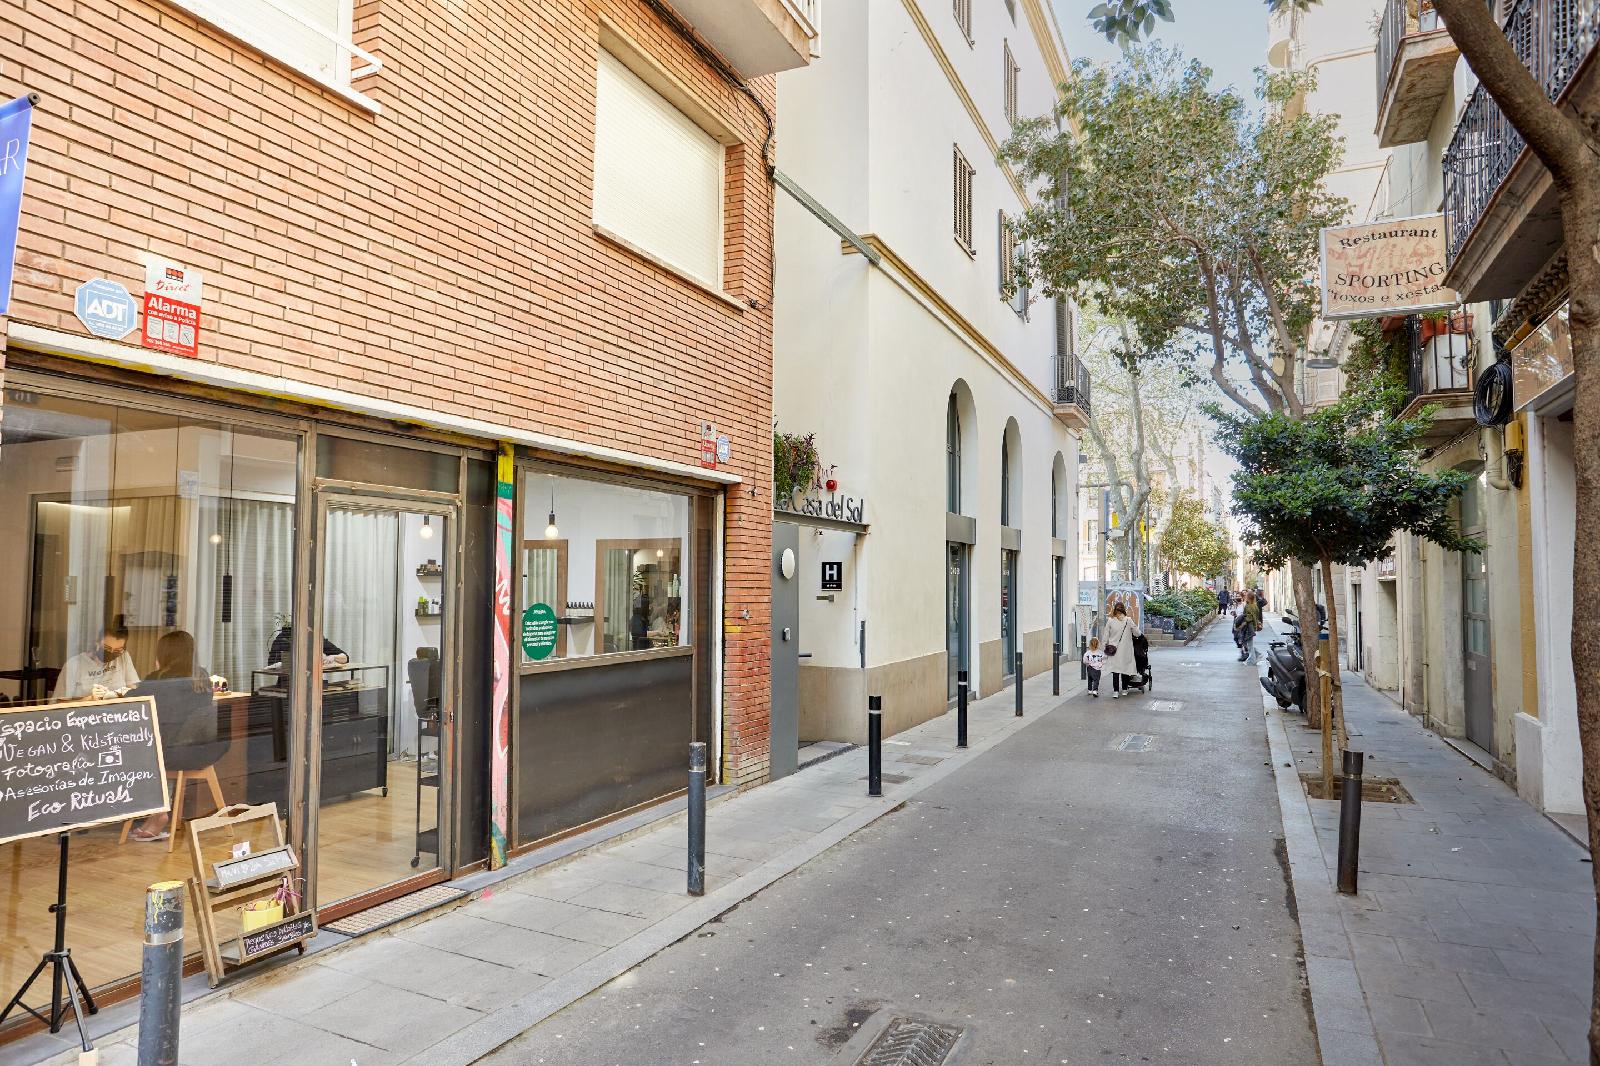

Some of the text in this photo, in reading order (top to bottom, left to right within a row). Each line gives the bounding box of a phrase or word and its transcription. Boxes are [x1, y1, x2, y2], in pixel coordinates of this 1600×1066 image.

[1338, 227, 1439, 249] Restaurant
[1334, 261, 1446, 289] SPORTING
[87, 298, 127, 321] ADT
[148, 297, 197, 319] Alarma
[1381, 294, 1390, 303] e
[791, 485, 822, 517] Casa
[825, 491, 845, 520] del
[846, 497, 864, 523] Sol
[825, 564, 838, 581] H
[66, 704, 149, 730] Experiencial
[61, 733, 75, 753] &
[79, 771, 95, 786] de
[98, 771, 153, 788] Imagen
[28, 785, 134, 822] Eco Rituals
